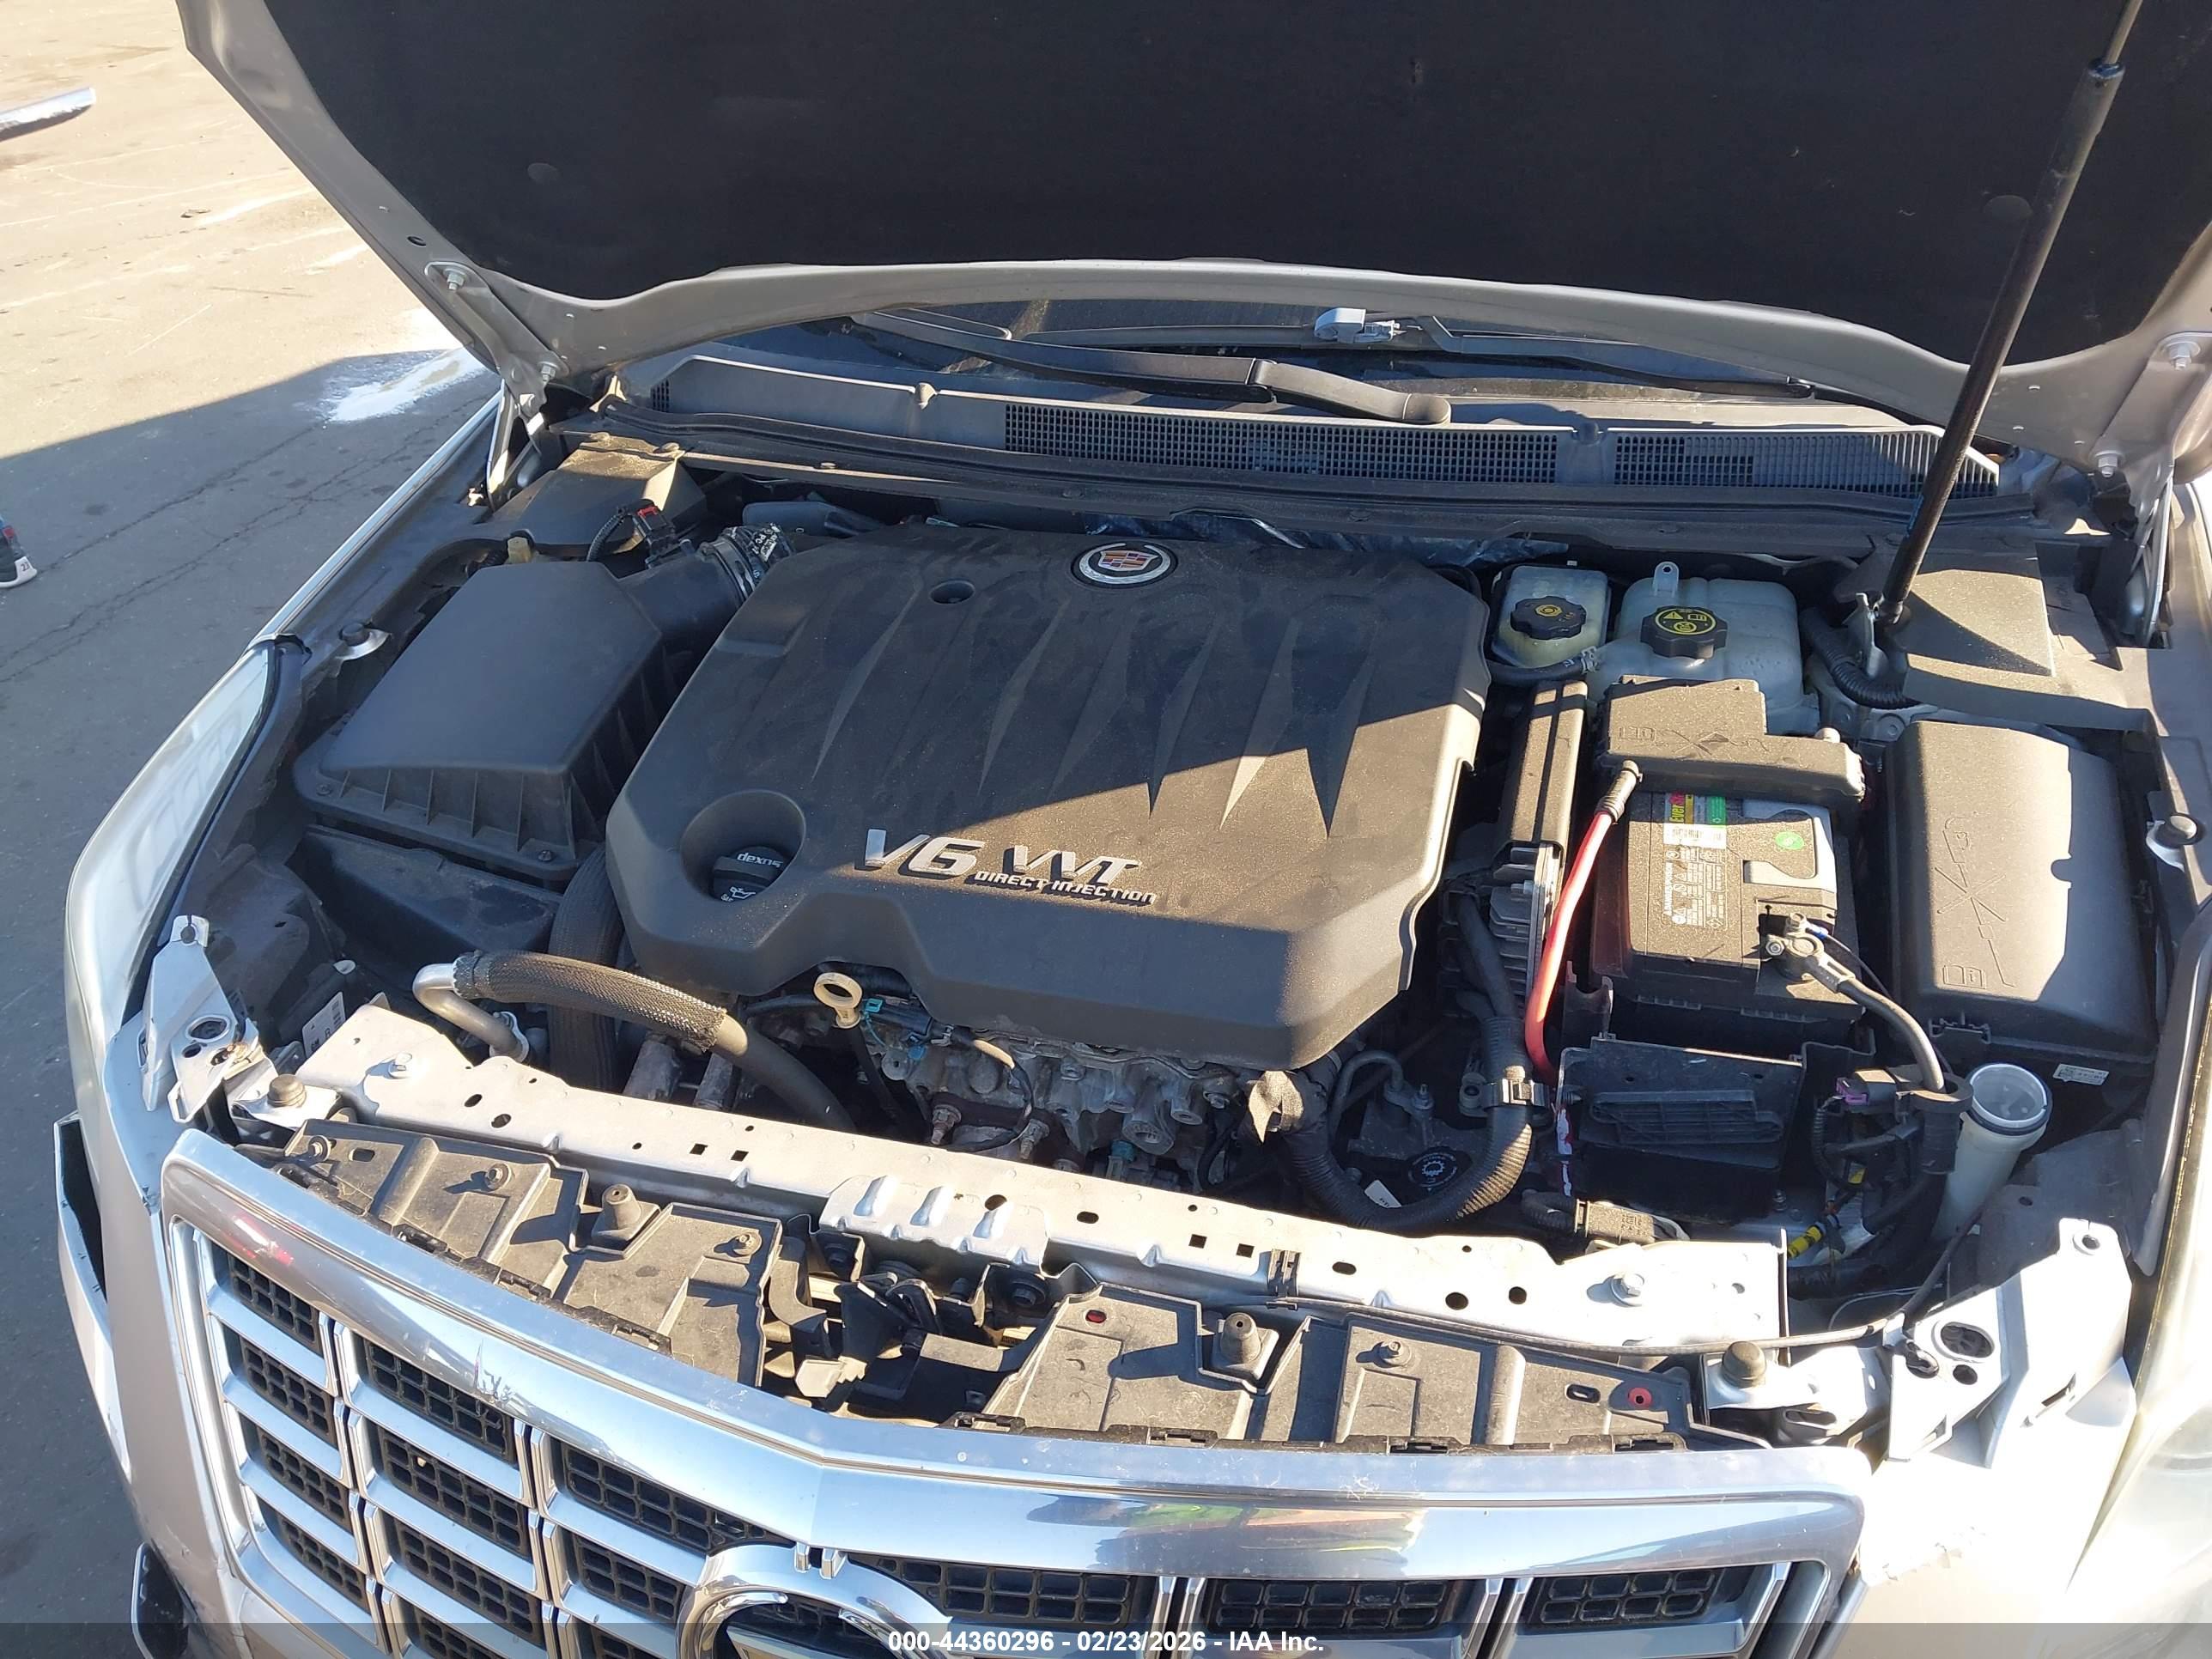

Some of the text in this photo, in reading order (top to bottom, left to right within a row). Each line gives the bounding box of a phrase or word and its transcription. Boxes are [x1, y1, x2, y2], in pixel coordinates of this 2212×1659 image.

[864, 828, 1142, 885] V6 VVT
[974, 870, 1157, 905] DIRECT INJECTION
